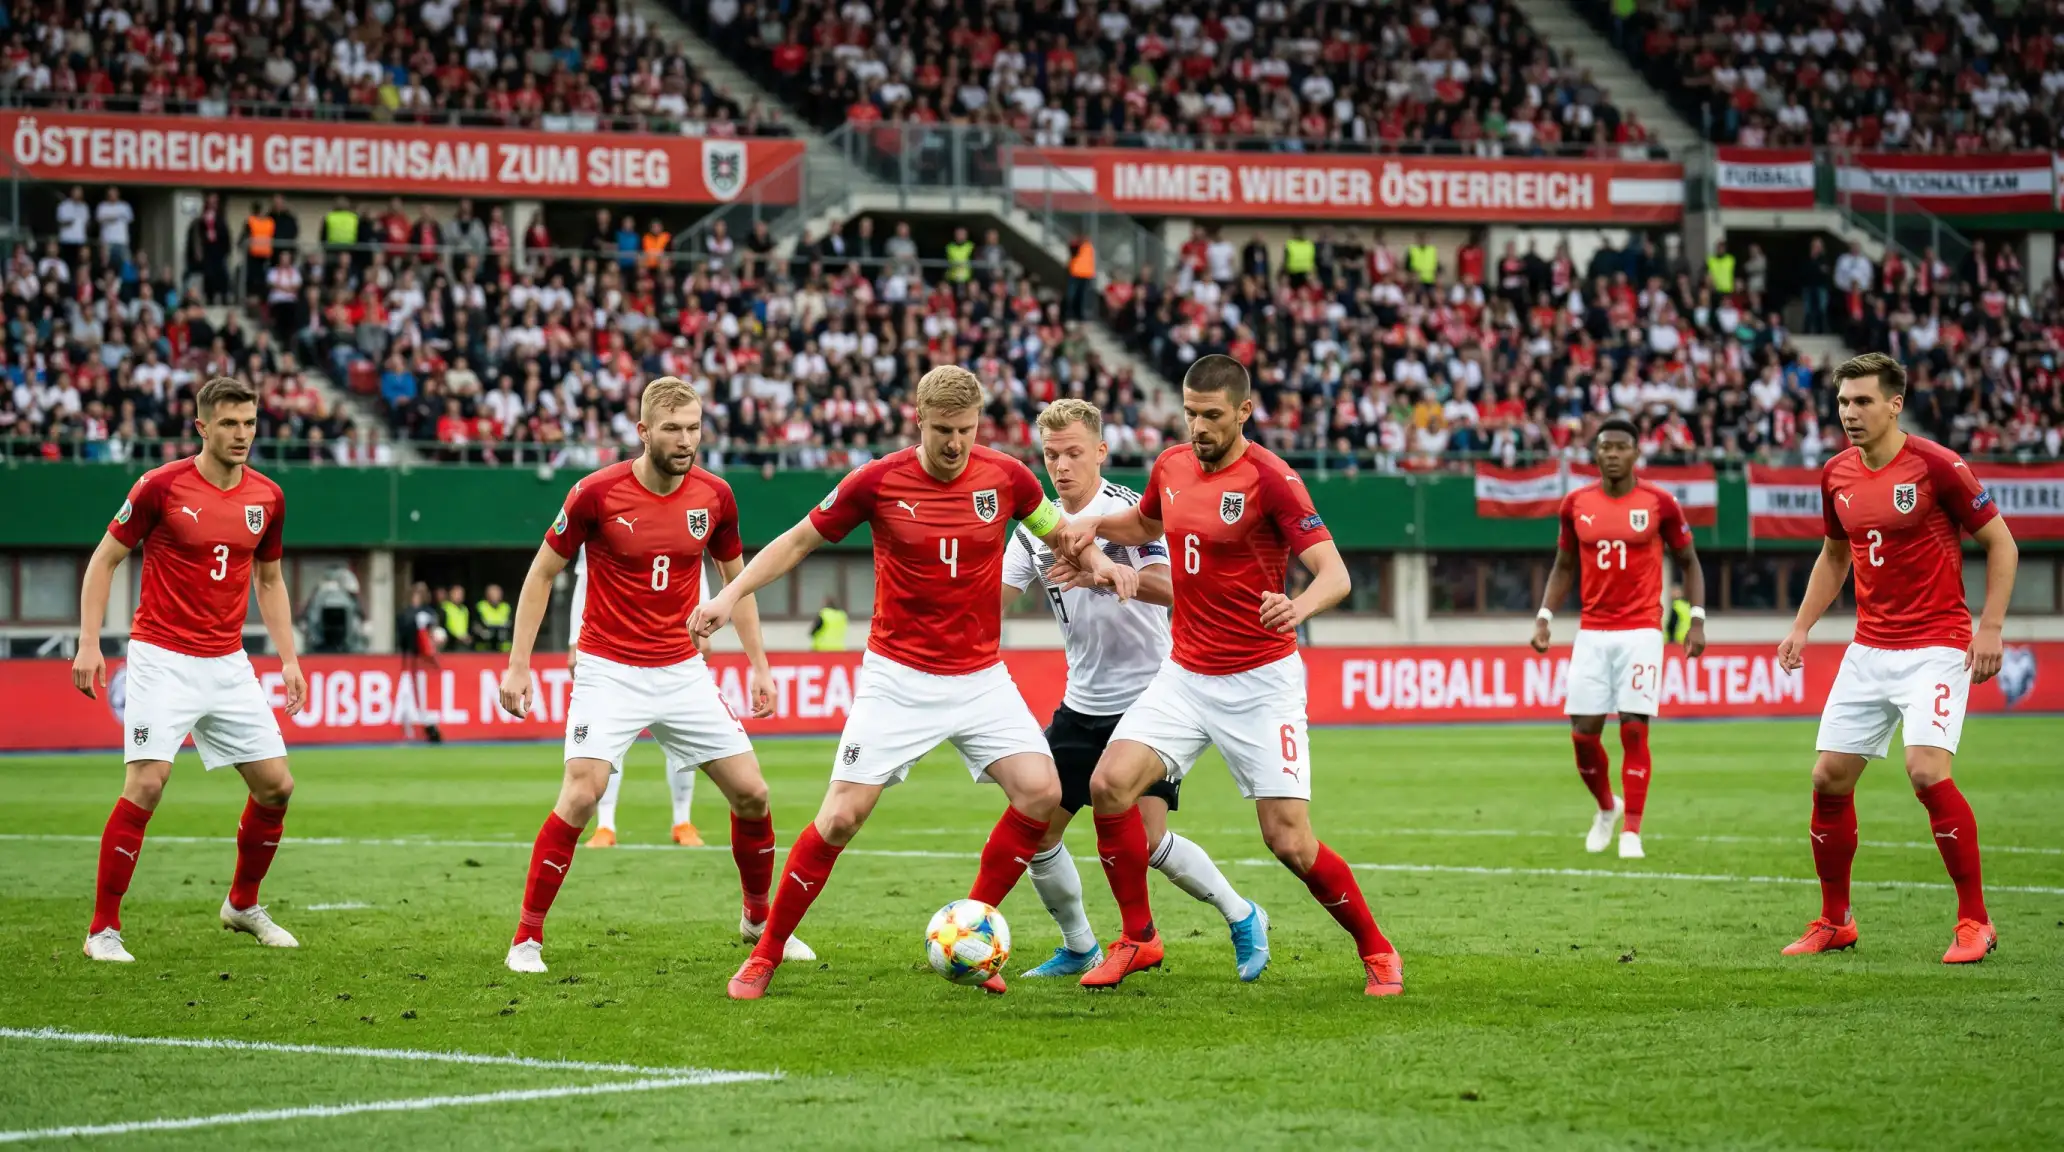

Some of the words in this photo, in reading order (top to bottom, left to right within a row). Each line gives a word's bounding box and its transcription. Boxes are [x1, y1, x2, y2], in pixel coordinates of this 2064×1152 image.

[13, 118, 253, 181] ÖSTERREICH
[264, 136, 489, 182] GEMEINSAM
[499, 144, 579, 187] ZUM
[588, 148, 670, 190] SIEG
[1113, 163, 1231, 204] IMMER
[1239, 167, 1373, 207] WIEDER
[1380, 163, 1593, 210] ÖSTERREICH
[210, 544, 230, 581] 3
[939, 537, 958, 578] 4
[1184, 533, 1200, 575] 6
[1867, 529, 1885, 567] 2
[651, 555, 671, 591] 8
[1934, 683, 1950, 718] 2
[1280, 723, 1298, 762] 6
